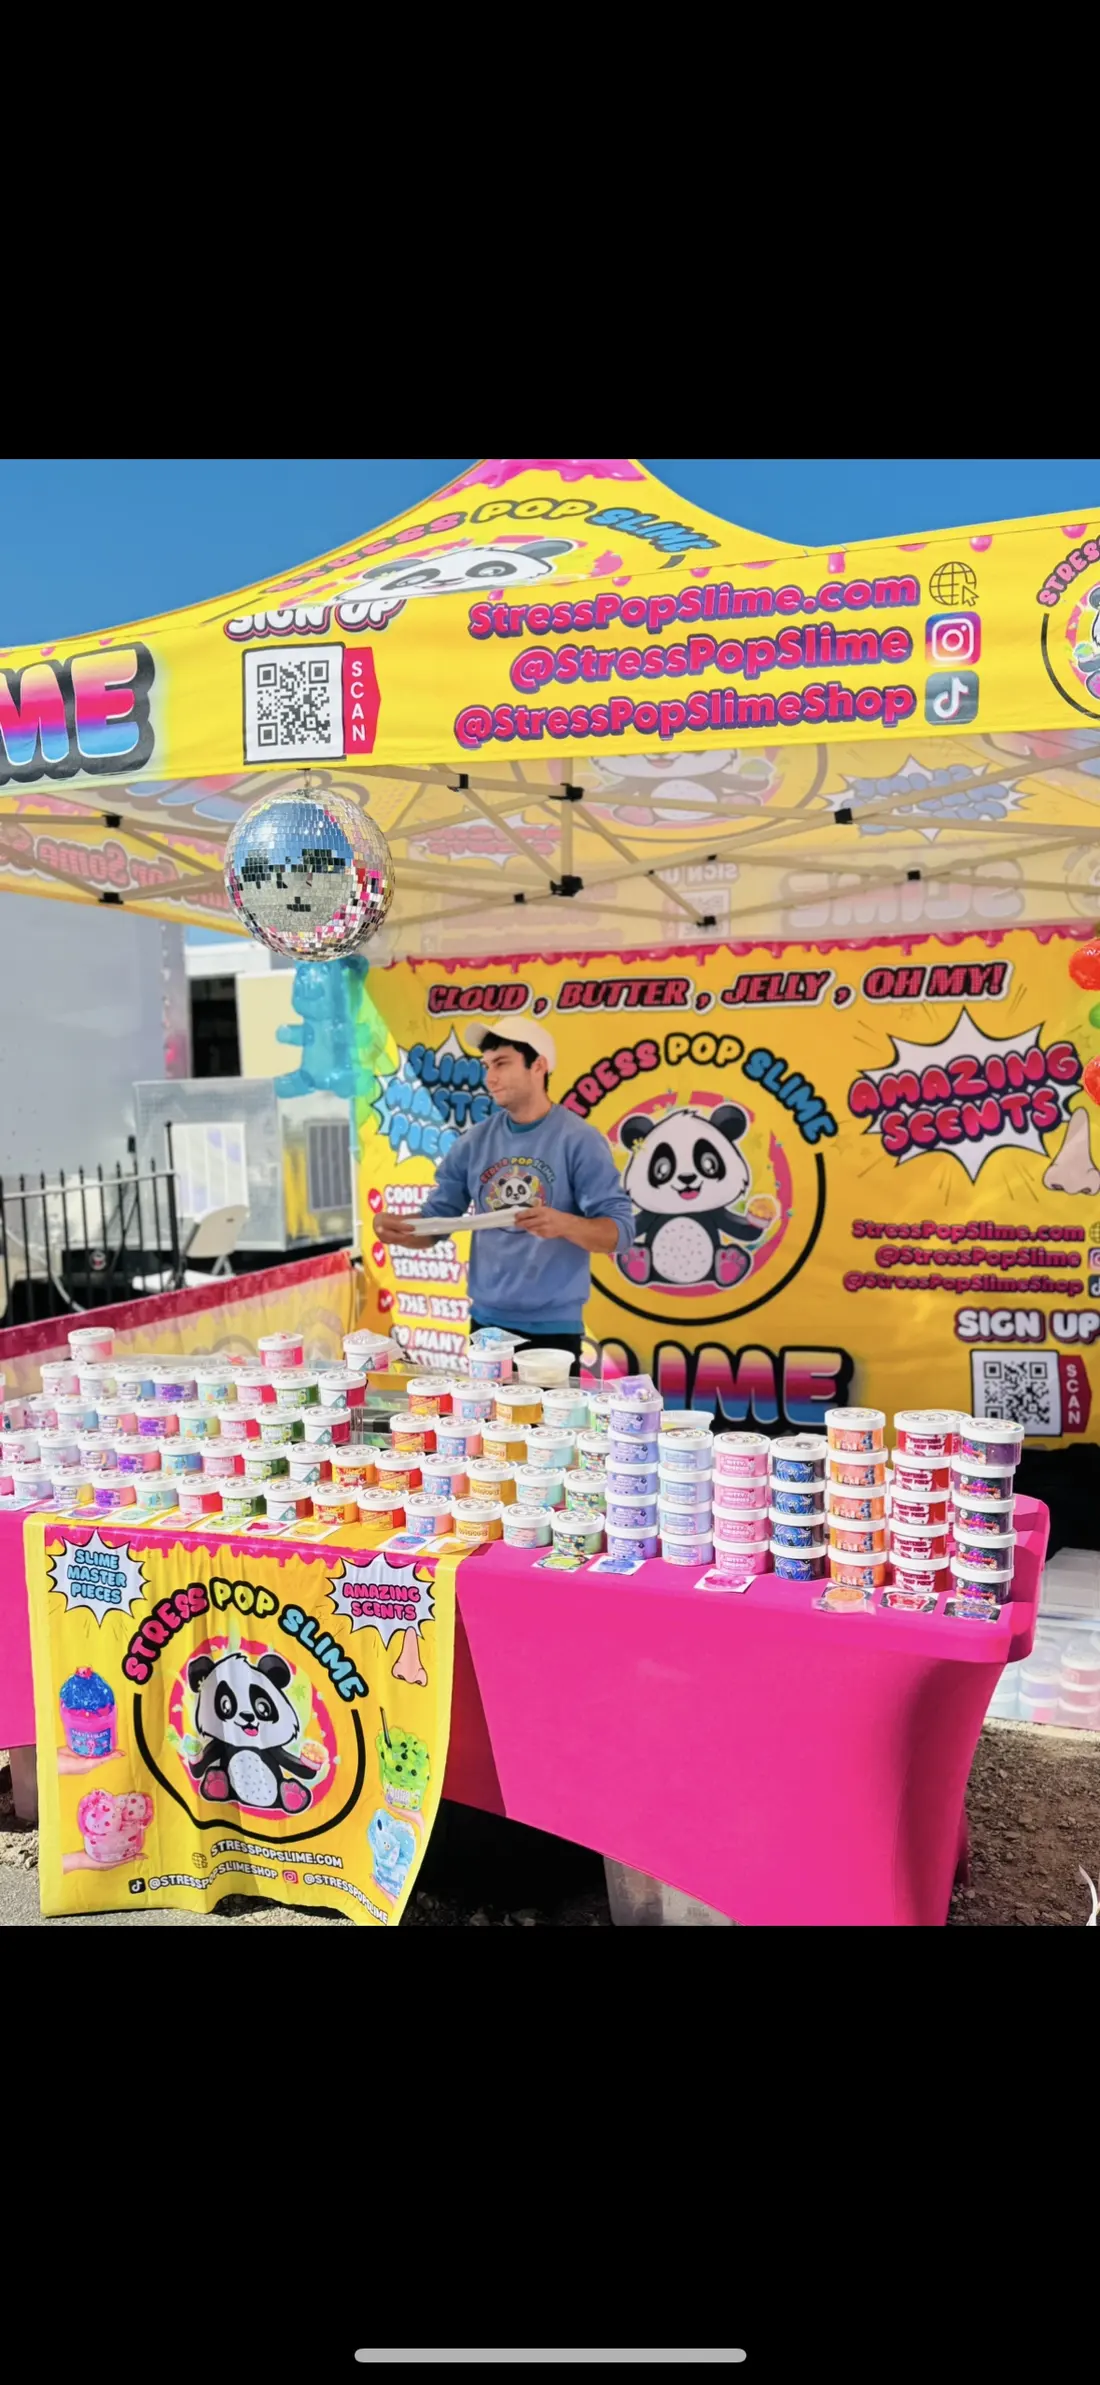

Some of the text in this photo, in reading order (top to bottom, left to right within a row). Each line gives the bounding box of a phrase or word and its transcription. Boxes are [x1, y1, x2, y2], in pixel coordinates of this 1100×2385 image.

[470, 497, 596, 524] POP
[585, 507, 720, 552] SLIME
[1037, 535, 1100, 607] STRES
[469, 575, 920, 639] StressPopSlime.com
[510, 623, 913, 693] @StressPopSlime
[350, 660, 366, 743] SCAN
[456, 683, 917, 749] @StressPopSlimeShop
[428, 984, 529, 1013] CLOUD
[557, 978, 690, 1009] BUTTER
[720, 970, 832, 1003] JELLY
[862, 966, 927, 999] OH
[925, 962, 1007, 997] MY!
[404, 1042, 486, 1087] SLIM
[848, 1041, 1082, 1118] AMAZING
[385, 1077, 495, 1125] MASTE
[559, 1032, 838, 1144] TRESS POP SLIME
[388, 1112, 461, 1157] PIEC
[881, 1085, 1062, 1155] SCENTS
[510, 1156, 534, 1167] POP
[852, 1218, 1085, 1244] StressPopSlime.com
[875, 1244, 1082, 1271] @StressPopSlime
[396, 1290, 471, 1320] THE BEST
[843, 1270, 1084, 1297] @StressPopSlimeShop
[414, 1327, 466, 1356] MANY
[954, 1306, 1100, 1344] SIGN UP
[1065, 1363, 1081, 1425] SCAN
[67, 1564, 127, 1588] MASTER
[74, 1549, 120, 1570] SLIME
[71, 1582, 122, 1604] PIECES
[343, 1582, 421, 1603] AMAZING
[351, 1600, 417, 1621] SCENTS
[122, 1576, 369, 1702] STRESS POP SLIME
[148, 1860, 278, 1890] @STRESSPOPSLIMESHOP
[210, 1838, 344, 1868] STRESSPOPSLIME.COM
